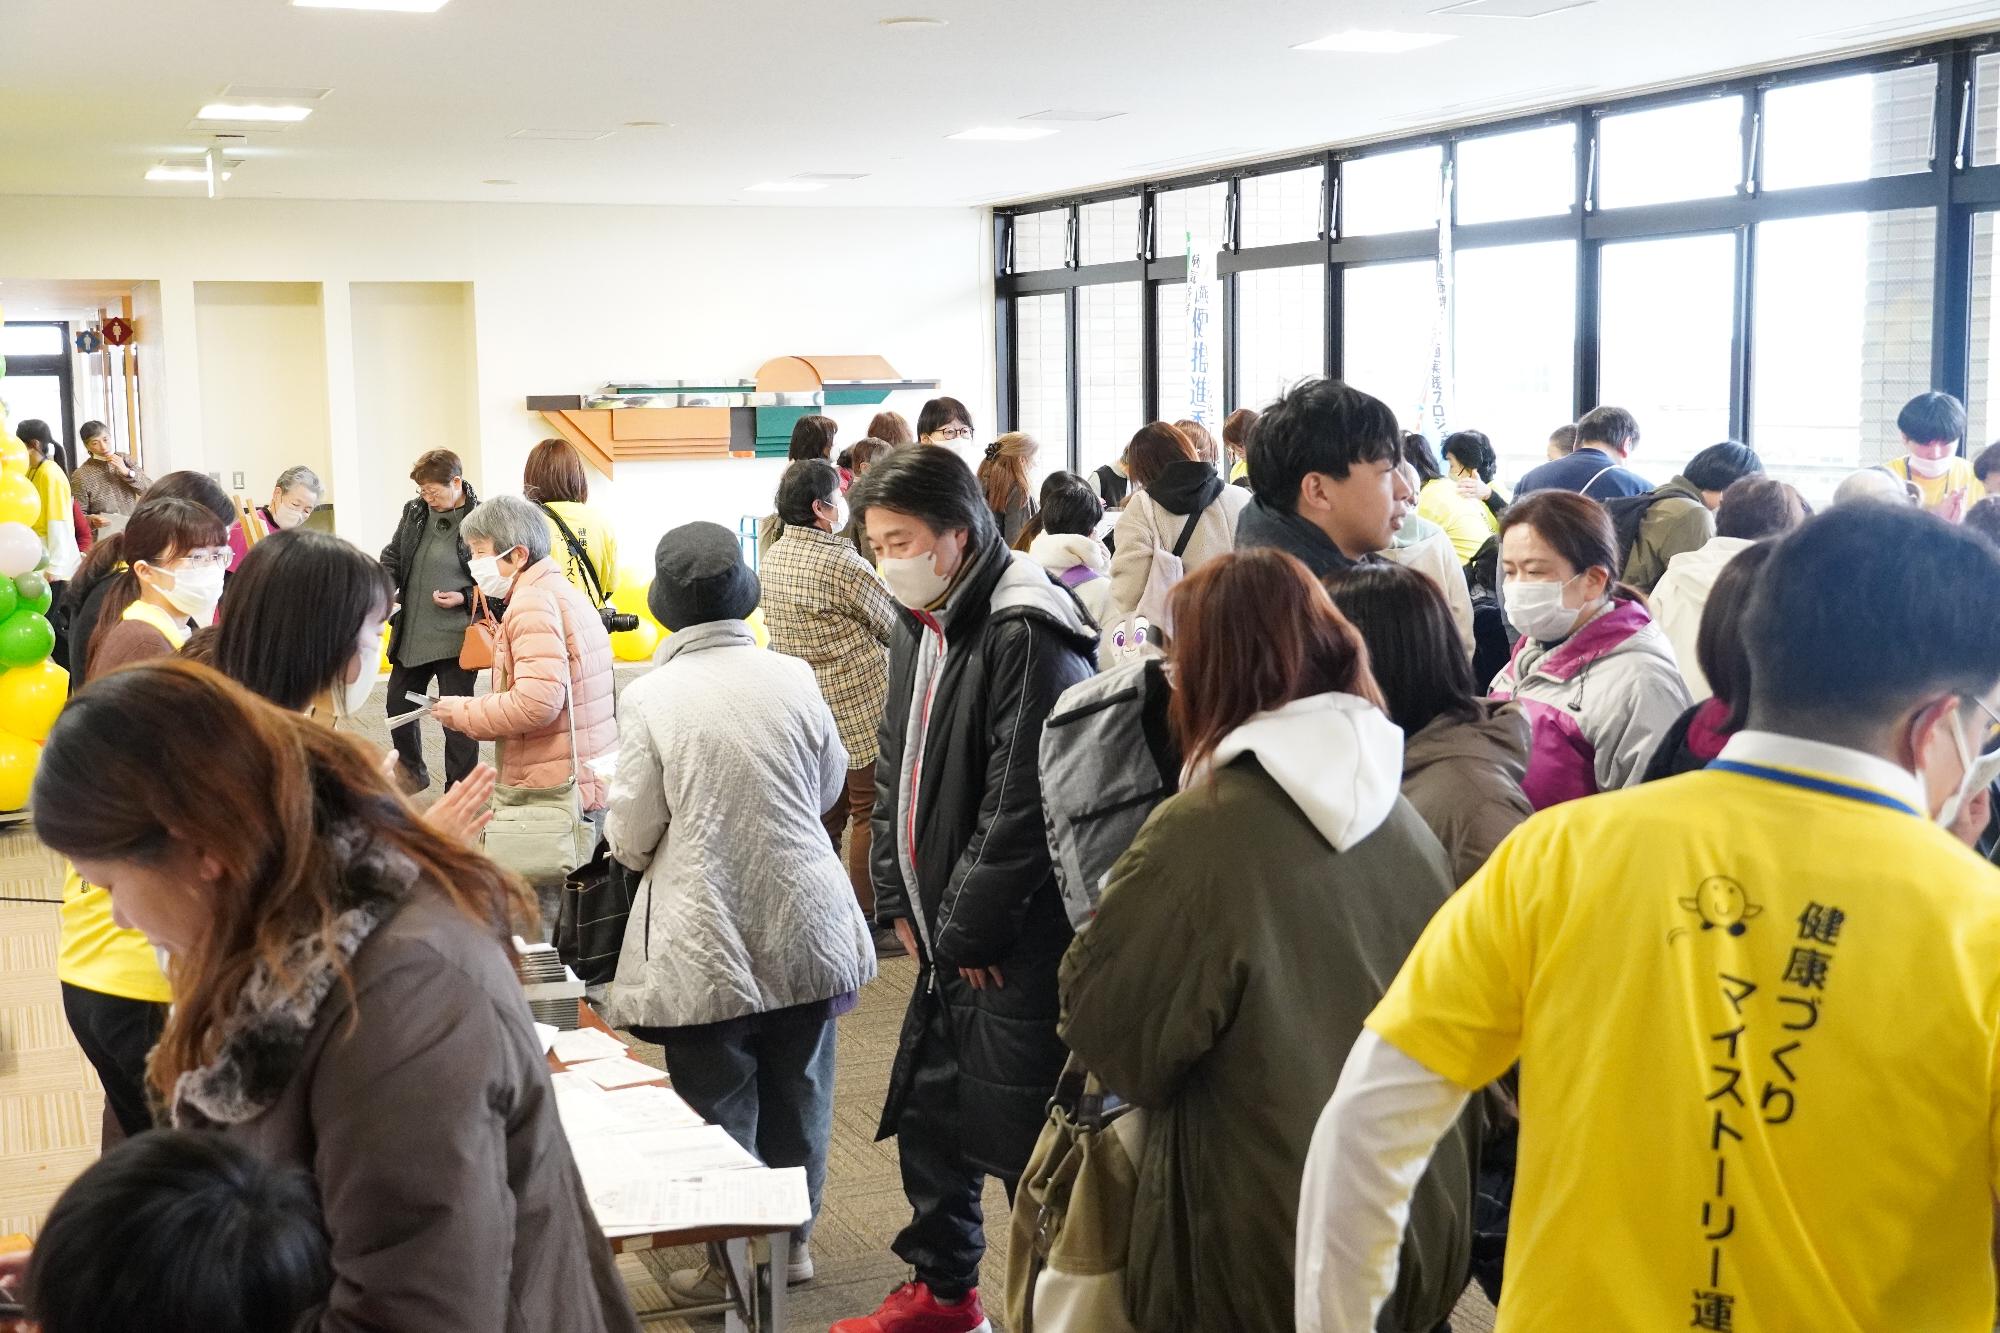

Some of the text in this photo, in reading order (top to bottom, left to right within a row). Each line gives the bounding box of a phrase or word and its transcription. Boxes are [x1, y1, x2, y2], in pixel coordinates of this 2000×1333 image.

[1690, 973, 1757, 1333] マイストーリー運
[1761, 901, 1846, 1124] 健康づくり
